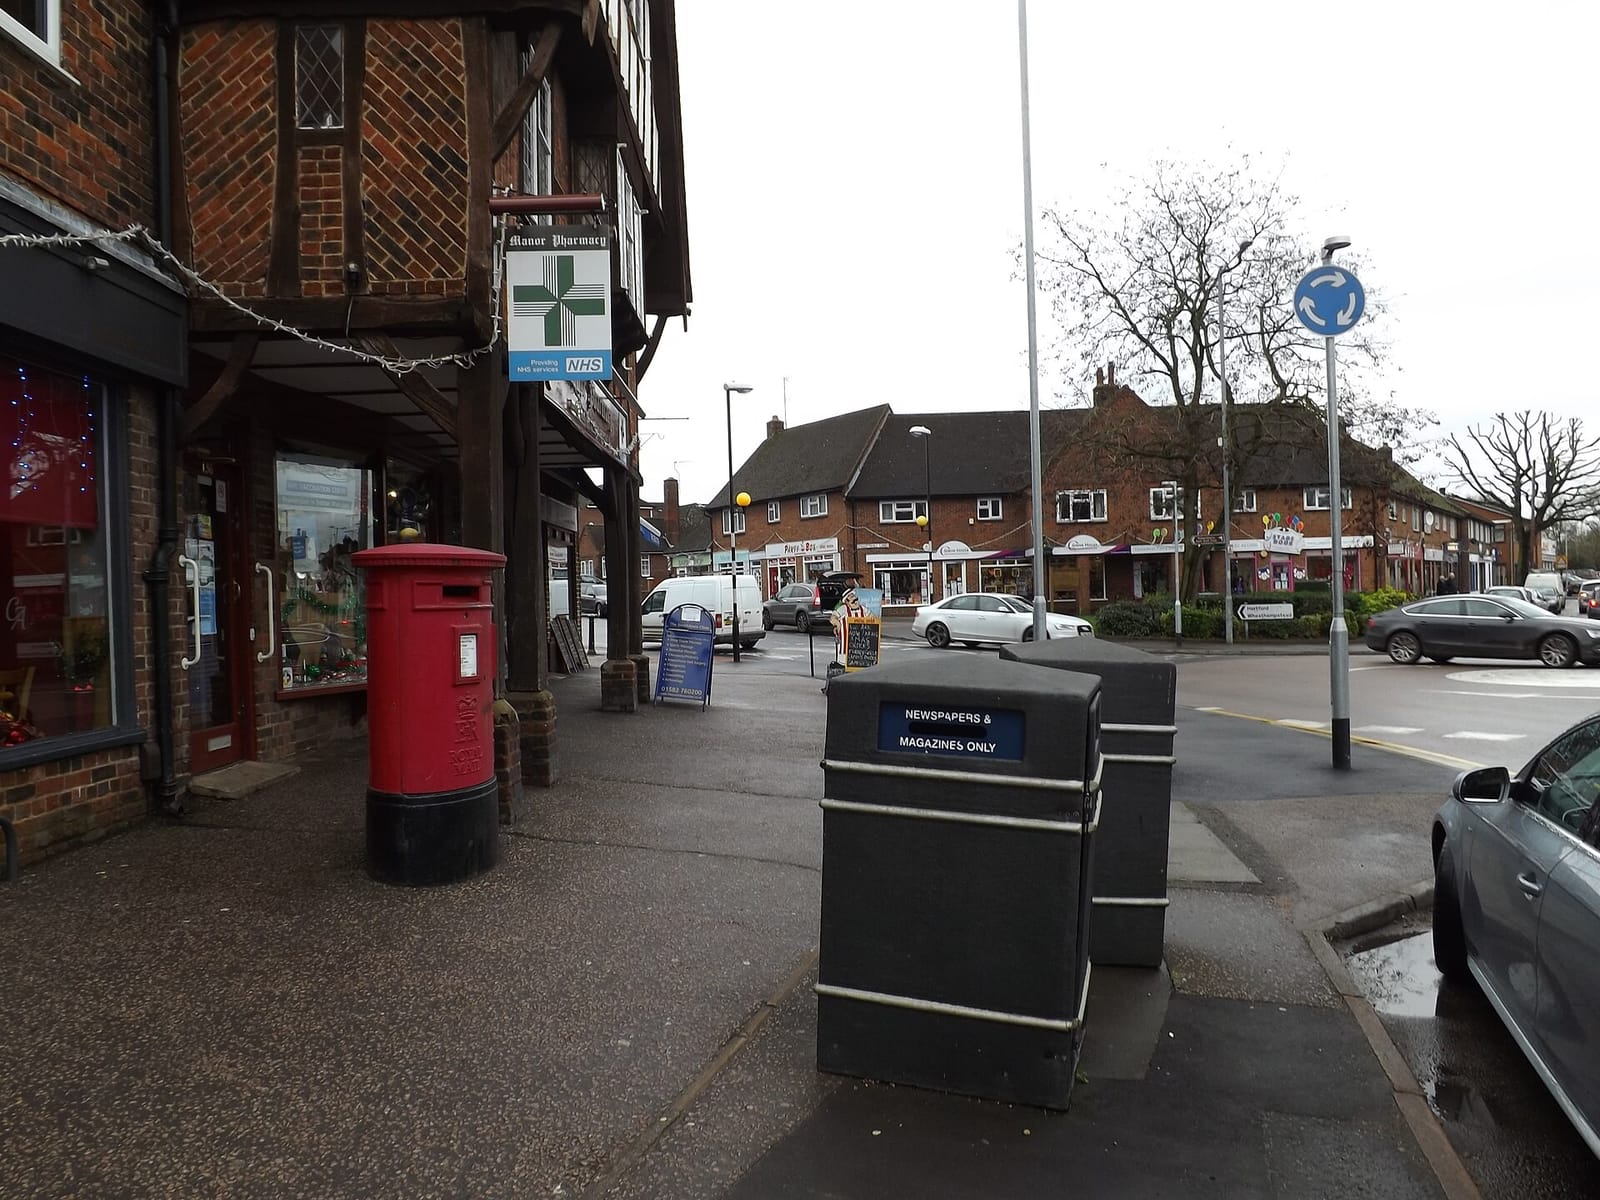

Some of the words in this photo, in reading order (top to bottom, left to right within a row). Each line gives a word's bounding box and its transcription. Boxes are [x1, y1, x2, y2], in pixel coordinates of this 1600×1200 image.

[509, 234, 546, 246] Manor
[552, 234, 606, 248] Pharmacy
[531, 359, 559, 367] Providing
[567, 359, 601, 371] NHS
[905, 709, 981, 724] NEWSPAPERS
[983, 713, 991, 724] &
[899, 736, 964, 750] MAGAZINES
[967, 741, 996, 753] ONLY
